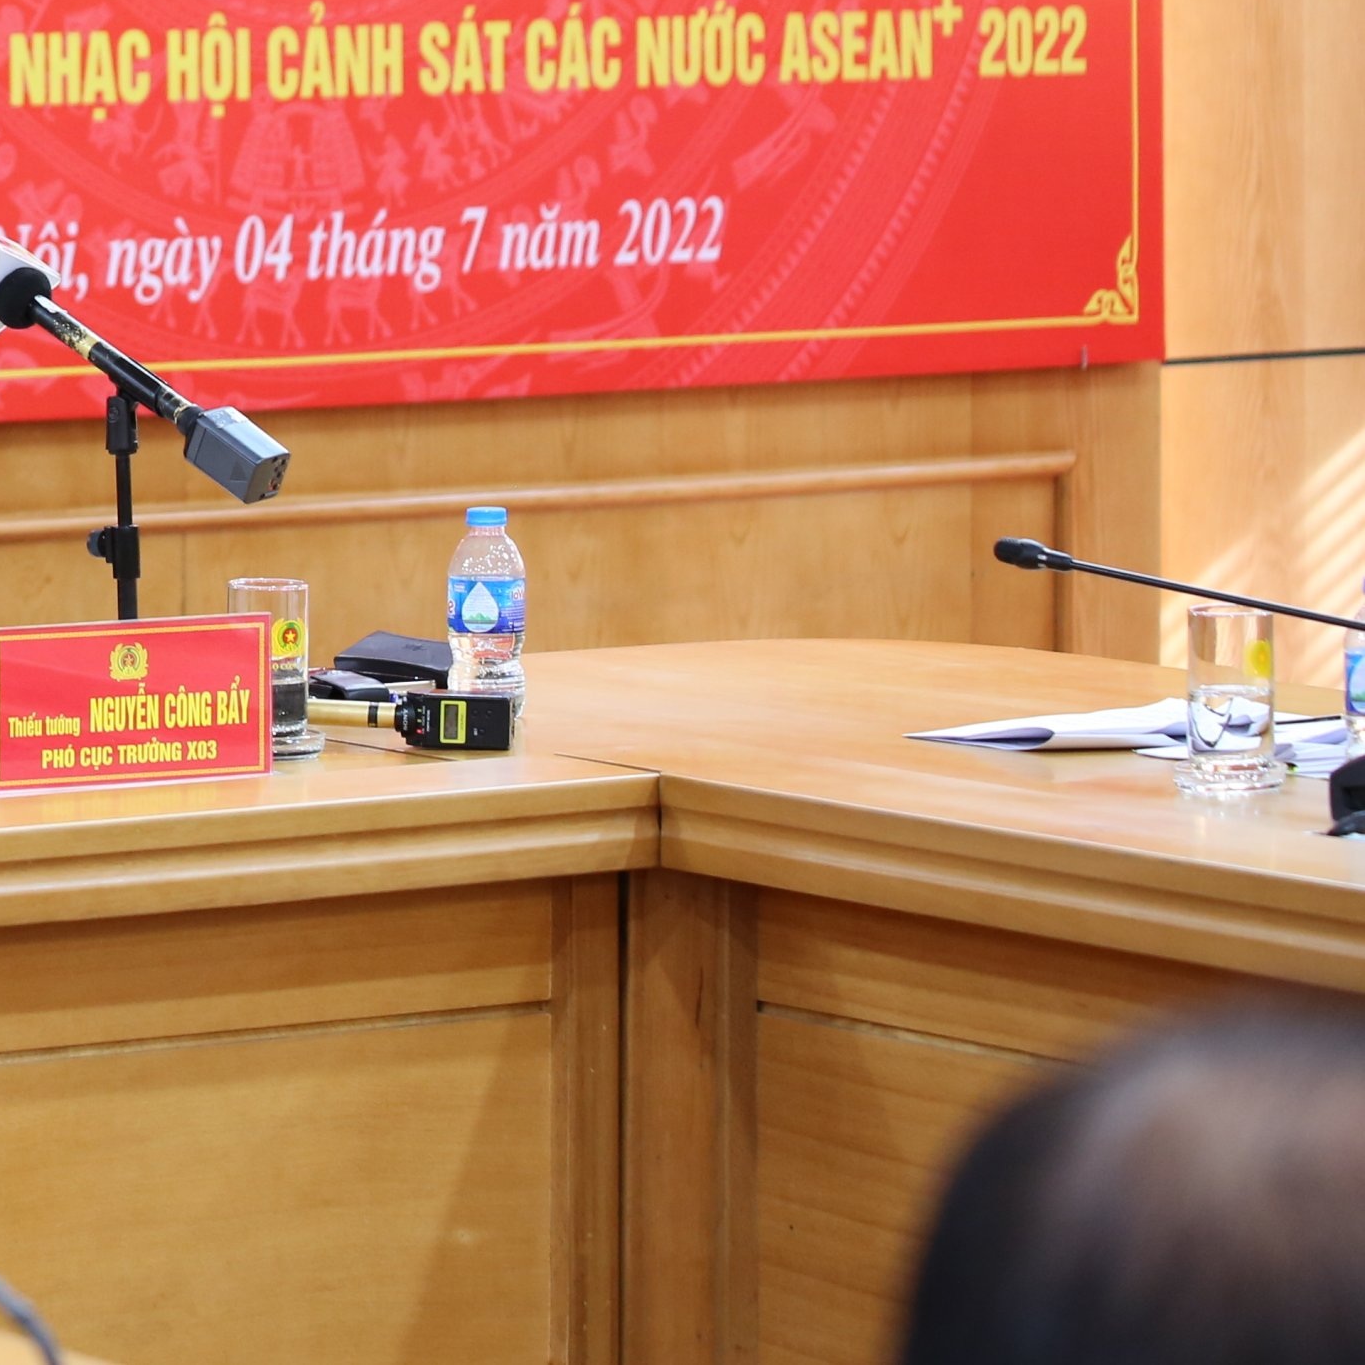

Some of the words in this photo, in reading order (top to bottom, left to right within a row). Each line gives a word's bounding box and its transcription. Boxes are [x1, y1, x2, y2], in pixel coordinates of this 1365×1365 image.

[9, 29, 150, 121] NHẠC
[167, 13, 250, 118] HỘI
[267, 1, 403, 100] CẢNH
[419, 6, 511, 95] SÁT
[526, 3, 621, 92] CÁC
[637, 0, 765, 87] NƯỚC
[979, 6, 1086, 76] 2022
[107, 218, 221, 303] ngày
[235, 215, 293, 282] 04
[308, 210, 444, 291] tháng
[462, 207, 486, 271] 7
[500, 205, 599, 269] năm
[615, 197, 723, 265] 2022
[8, 712, 42, 738] Thiếu
[46, 715, 81, 737] tướng
[89, 683, 159, 733] NGUYỄN
[164, 685, 212, 728] CÔNG
[217, 675, 251, 725] BẨY
[42, 745, 75, 769] PHÓ
[80, 745, 113, 770] CỤC
[117, 737, 182, 764] TRƯỞNG
[187, 740, 217, 760] X03
